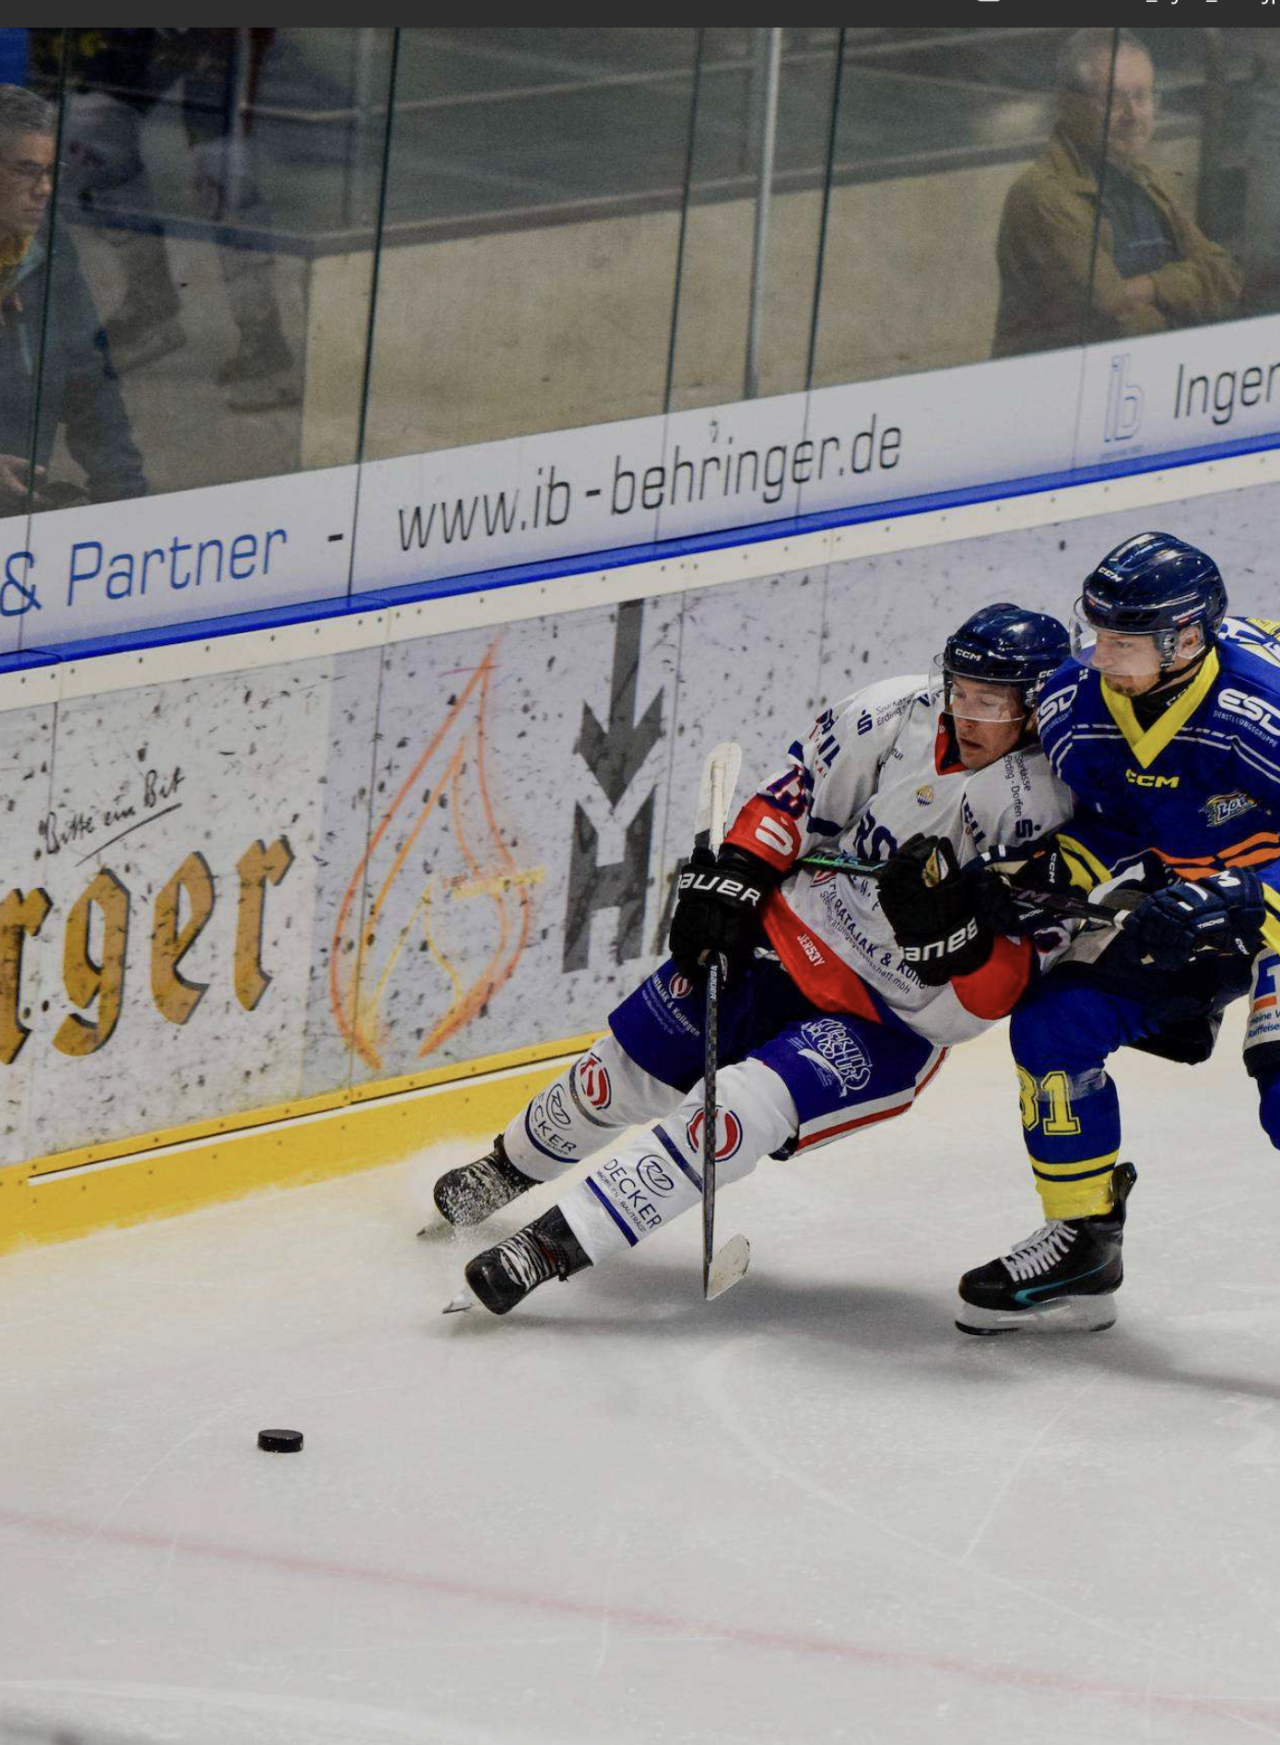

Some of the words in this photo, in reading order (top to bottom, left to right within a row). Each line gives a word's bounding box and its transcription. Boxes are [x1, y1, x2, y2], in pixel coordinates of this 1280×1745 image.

[0, 550, 42, 617] &
[67, 528, 288, 606] Partner
[1097, 566, 1123, 582] CCM
[955, 647, 982, 662] CCM
[1038, 668, 1059, 679] CC
[1125, 768, 1180, 788] CCM
[46, 811, 95, 854] Bitte
[143, 766, 185, 808] Bit
[1011, 785, 1024, 817] Dorfen
[1048, 852, 1057, 884] CCM
[834, 898, 881, 958] RATAJAK
[880, 952, 892, 967] &
[0, 834, 296, 1066] rger
[892, 975, 912, 995] mbH
[534, 1105, 577, 1153] CKER
[603, 1158, 663, 1229] DECKER
